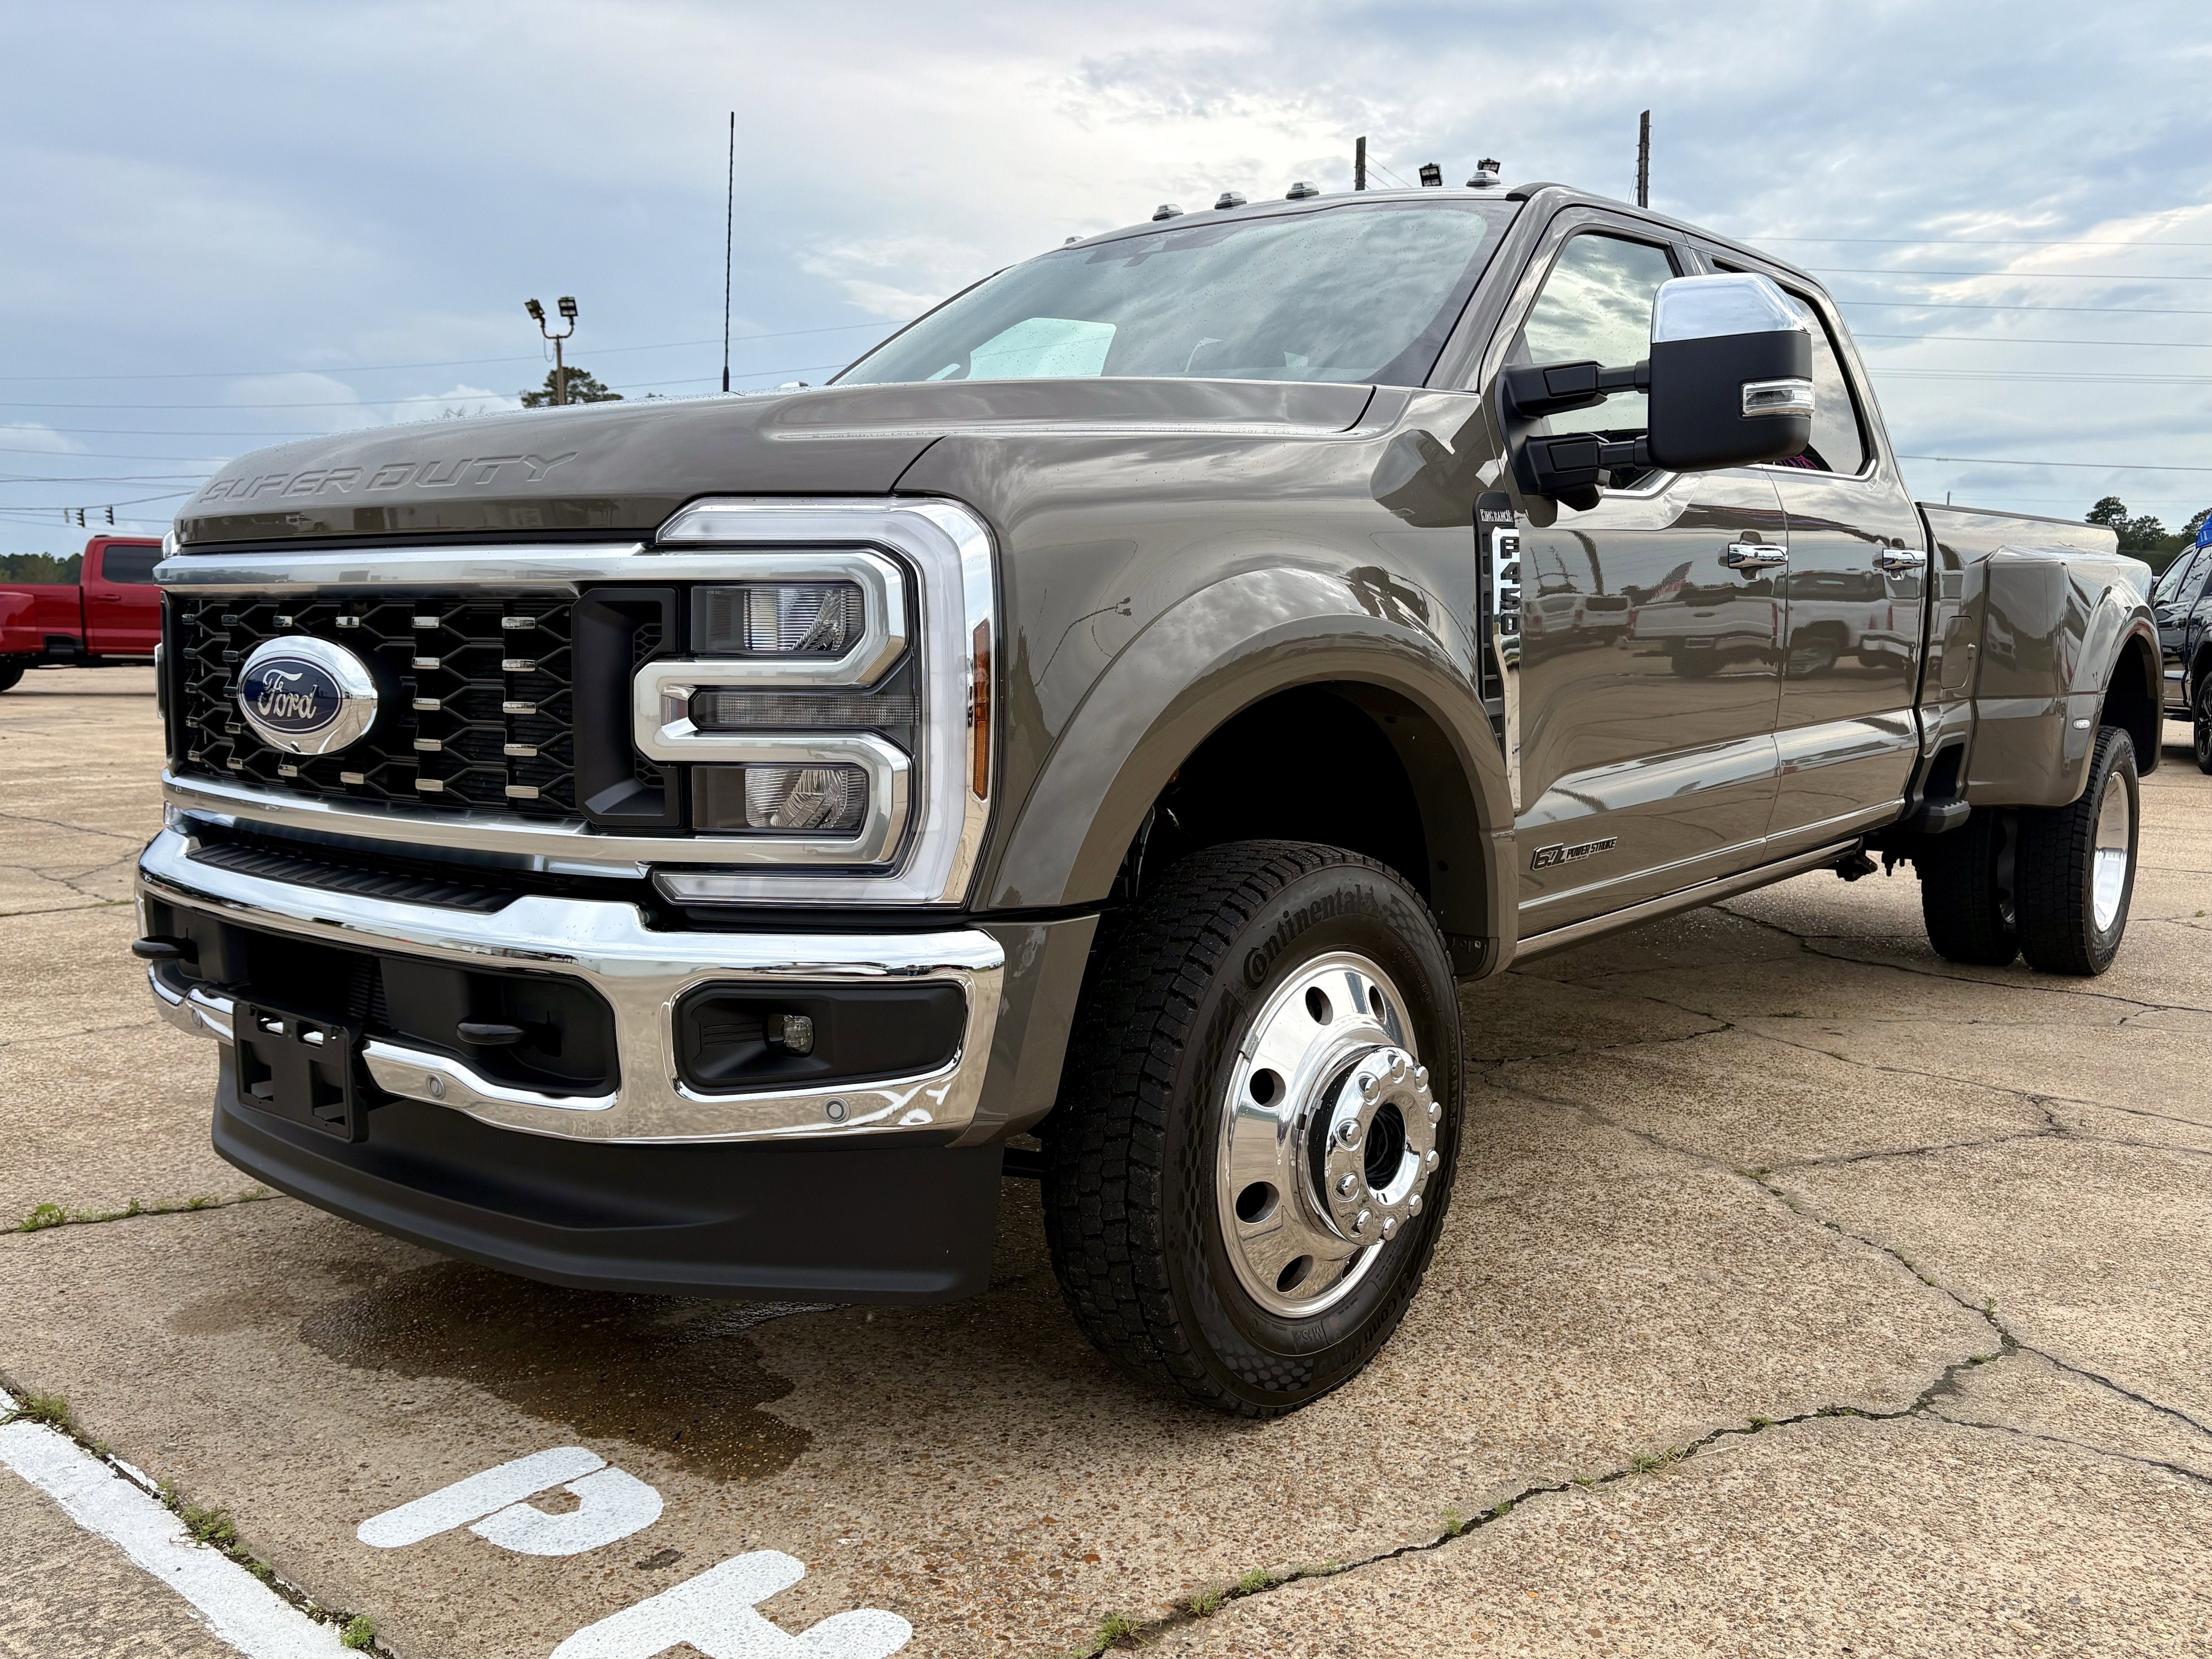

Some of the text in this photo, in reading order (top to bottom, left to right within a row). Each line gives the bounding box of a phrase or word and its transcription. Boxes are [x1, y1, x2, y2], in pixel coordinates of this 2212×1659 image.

[199, 452, 578, 503] SUPER DUTY
[1480, 509, 1494, 522] KING
[258, 669, 316, 719] Ford
[1566, 838, 1616, 859] POWER STROKE
[1243, 884, 1362, 991] Continental
